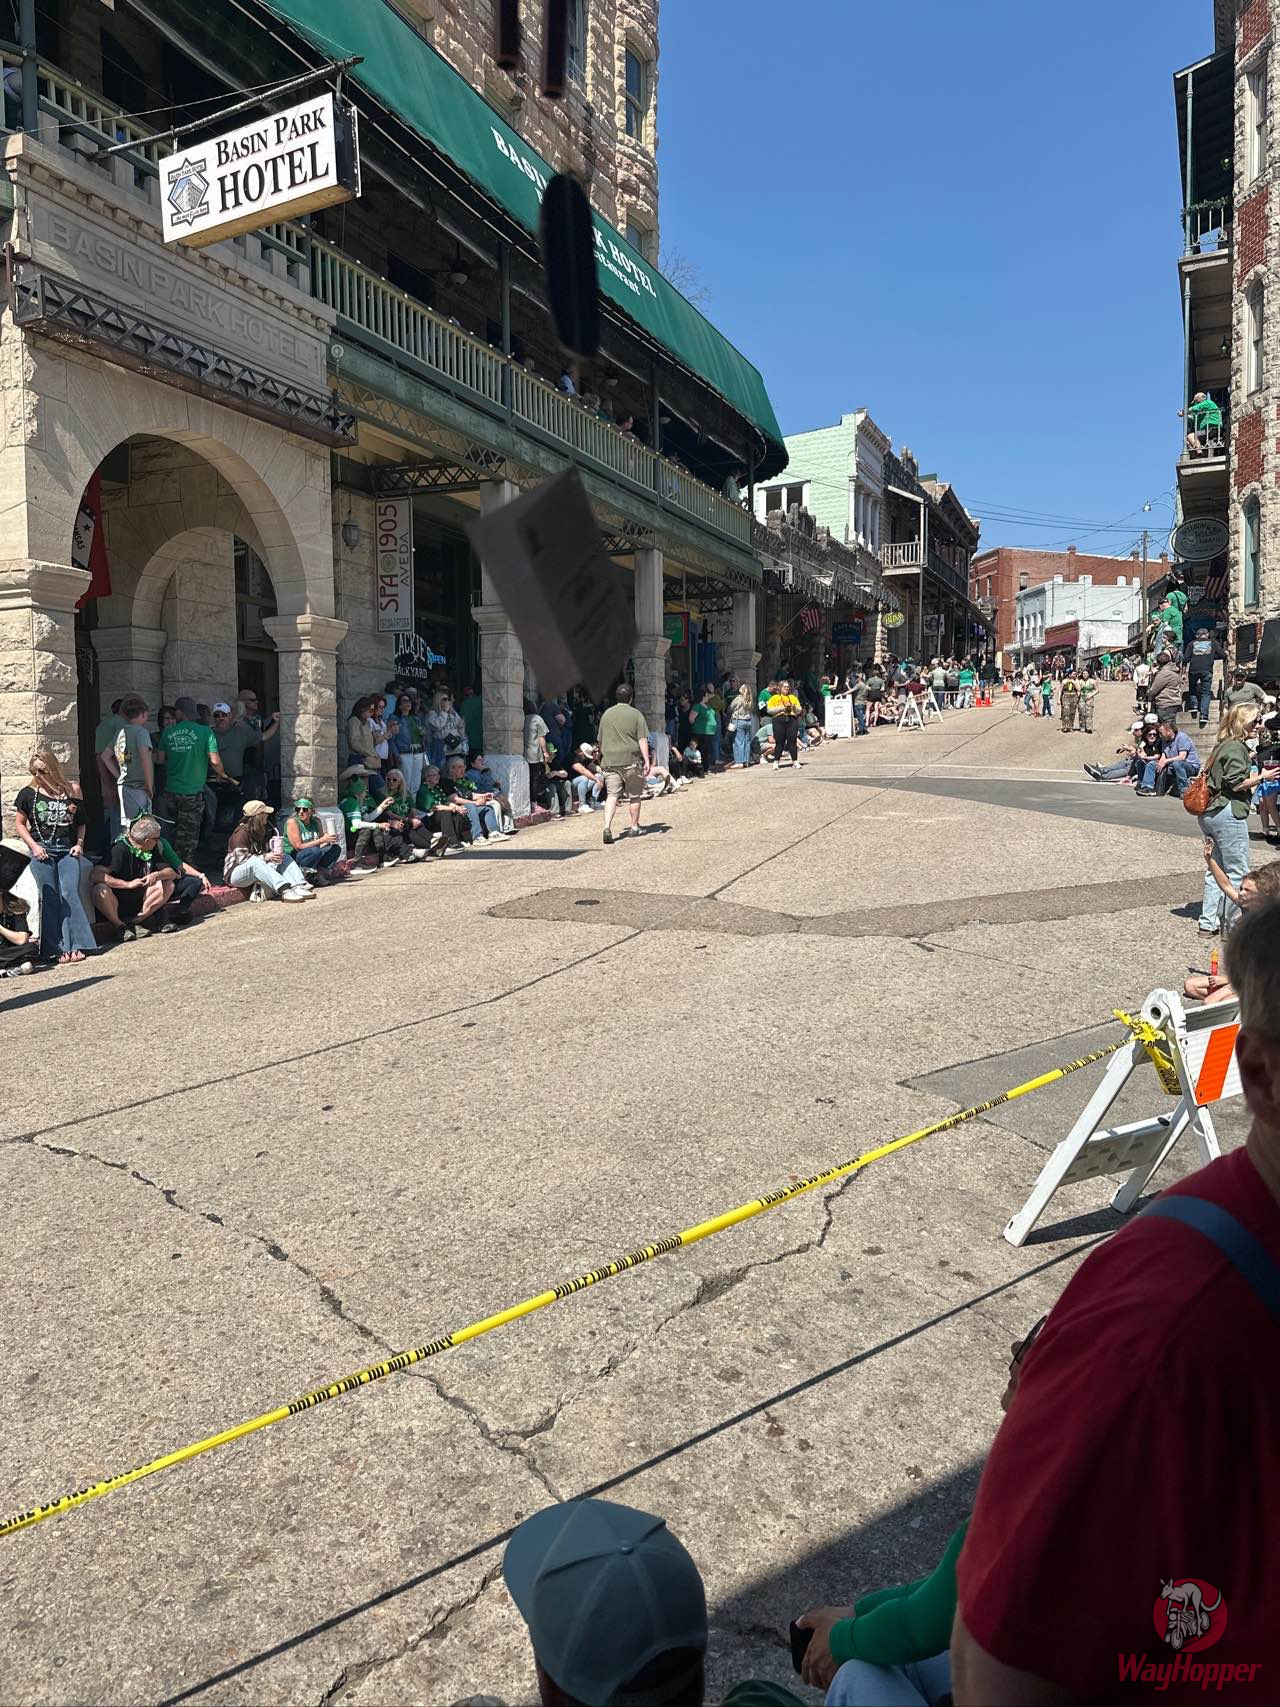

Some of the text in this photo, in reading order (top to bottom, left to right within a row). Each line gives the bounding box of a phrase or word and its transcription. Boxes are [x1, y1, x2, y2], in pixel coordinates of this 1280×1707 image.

[215, 106, 327, 168] BASIN PARK
[217, 141, 329, 213] HOTEL
[47, 215, 311, 368] BASIN PARK HOTEL
[607, 239, 657, 298] HOTEL
[378, 503, 398, 553] 1905
[398, 531, 409, 587] AVEDA
[379, 573, 399, 613] SPA
